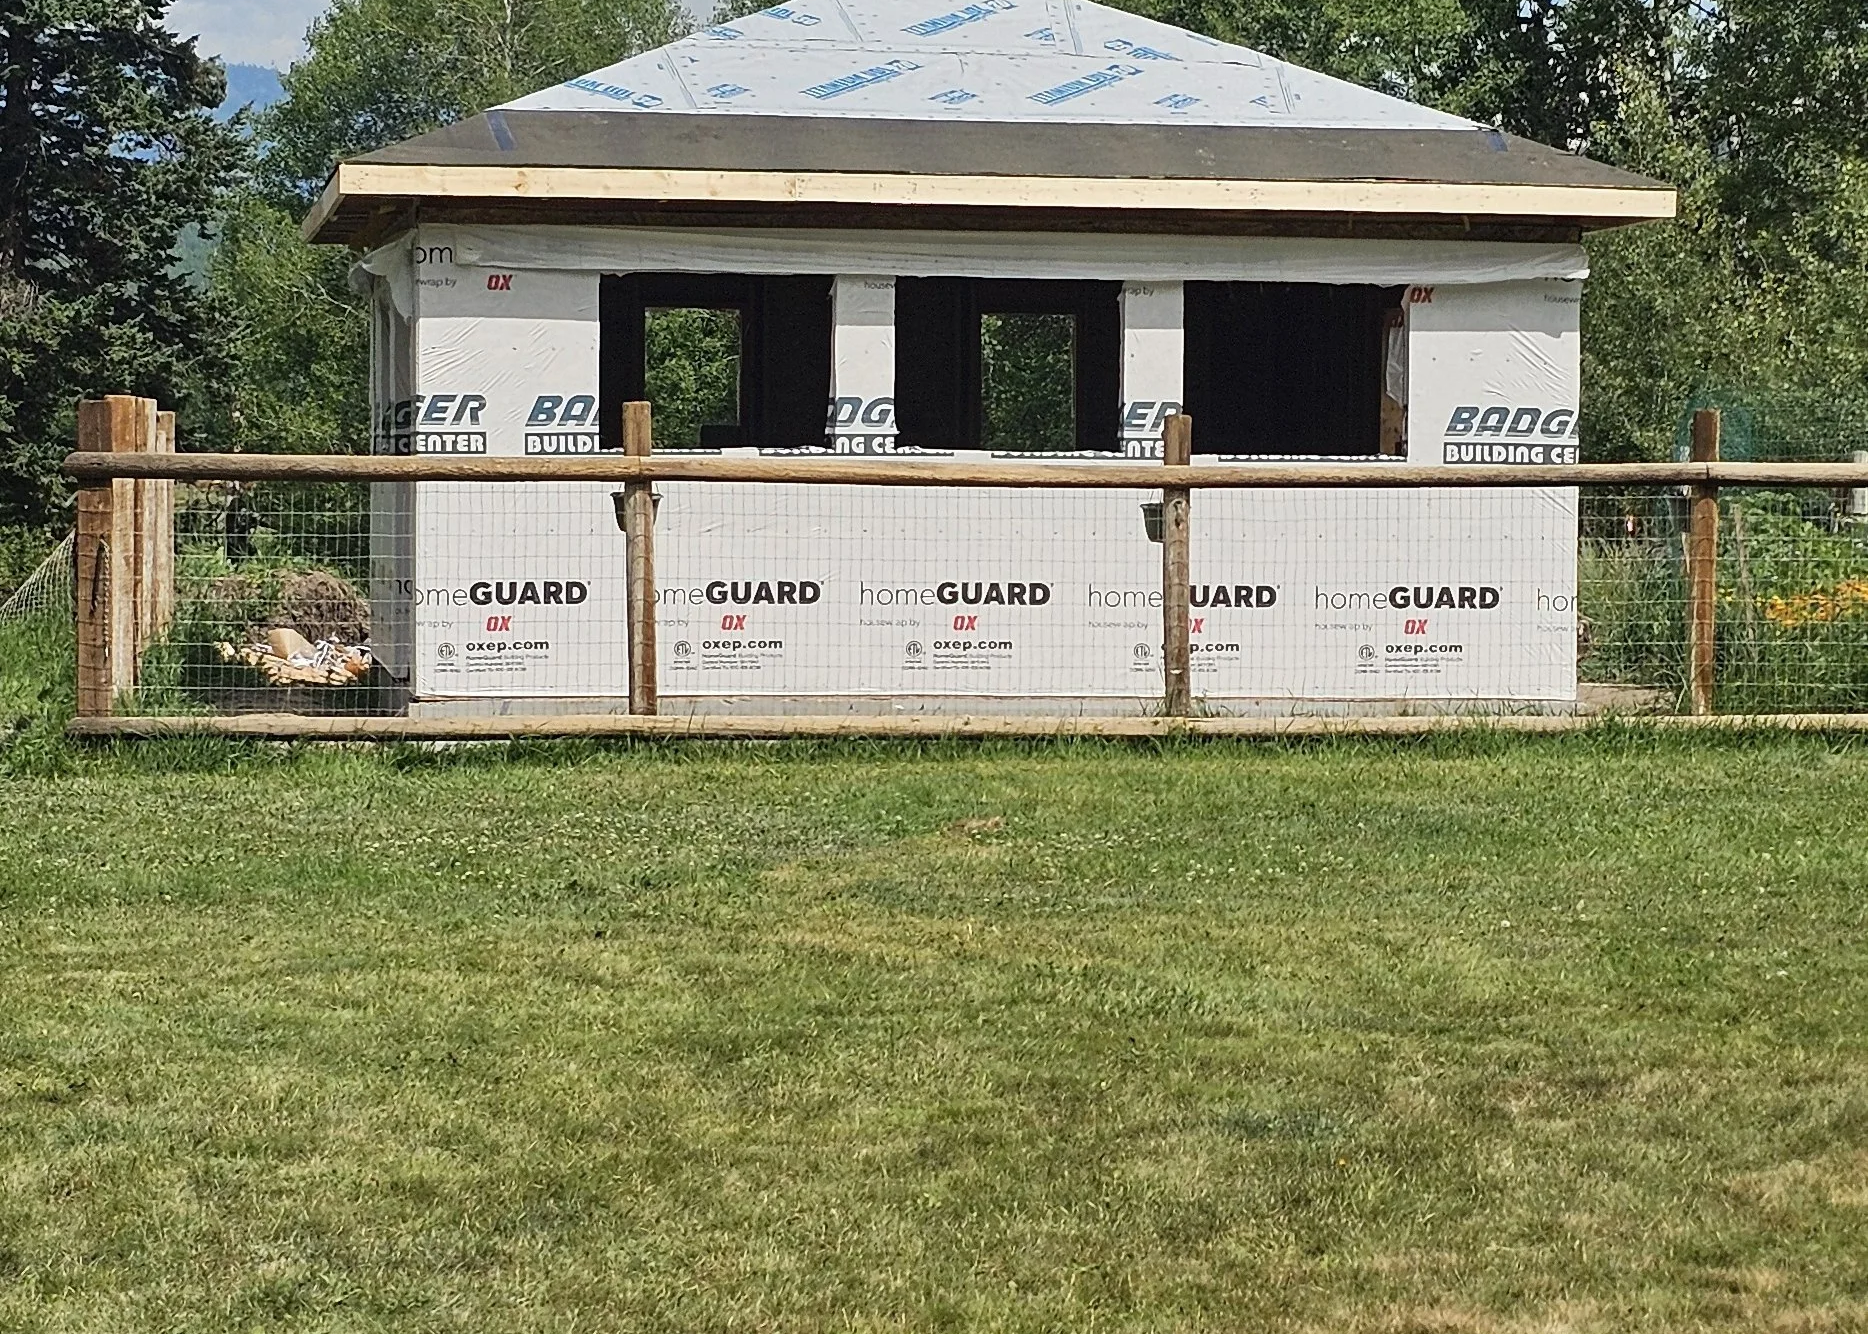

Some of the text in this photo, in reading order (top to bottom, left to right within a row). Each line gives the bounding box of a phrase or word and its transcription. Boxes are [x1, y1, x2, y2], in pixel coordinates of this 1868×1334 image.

[415, 278, 443, 288] wrap
[487, 273, 513, 291] OX
[525, 395, 599, 427] BA
[827, 396, 895, 428] DG
[1124, 401, 1183, 432] ER
[1444, 406, 1578, 439] BADG
[1445, 445, 1579, 464] BUILDING CE
[859, 581, 1051, 606] homeGUARD
[1088, 583, 1277, 608] homeUARD
[1315, 585, 1500, 610] homeGUARD
[486, 615, 512, 632] OX
[721, 615, 747, 631] OX
[953, 615, 978, 631] OX
[1188, 618, 1205, 634] X
[1403, 619, 1428, 635] OX
[465, 640, 550, 653] oxep.com
[702, 640, 783, 651] oxep.com
[933, 640, 1013, 652] oxep.com
[1385, 644, 1463, 655] oxep.com
